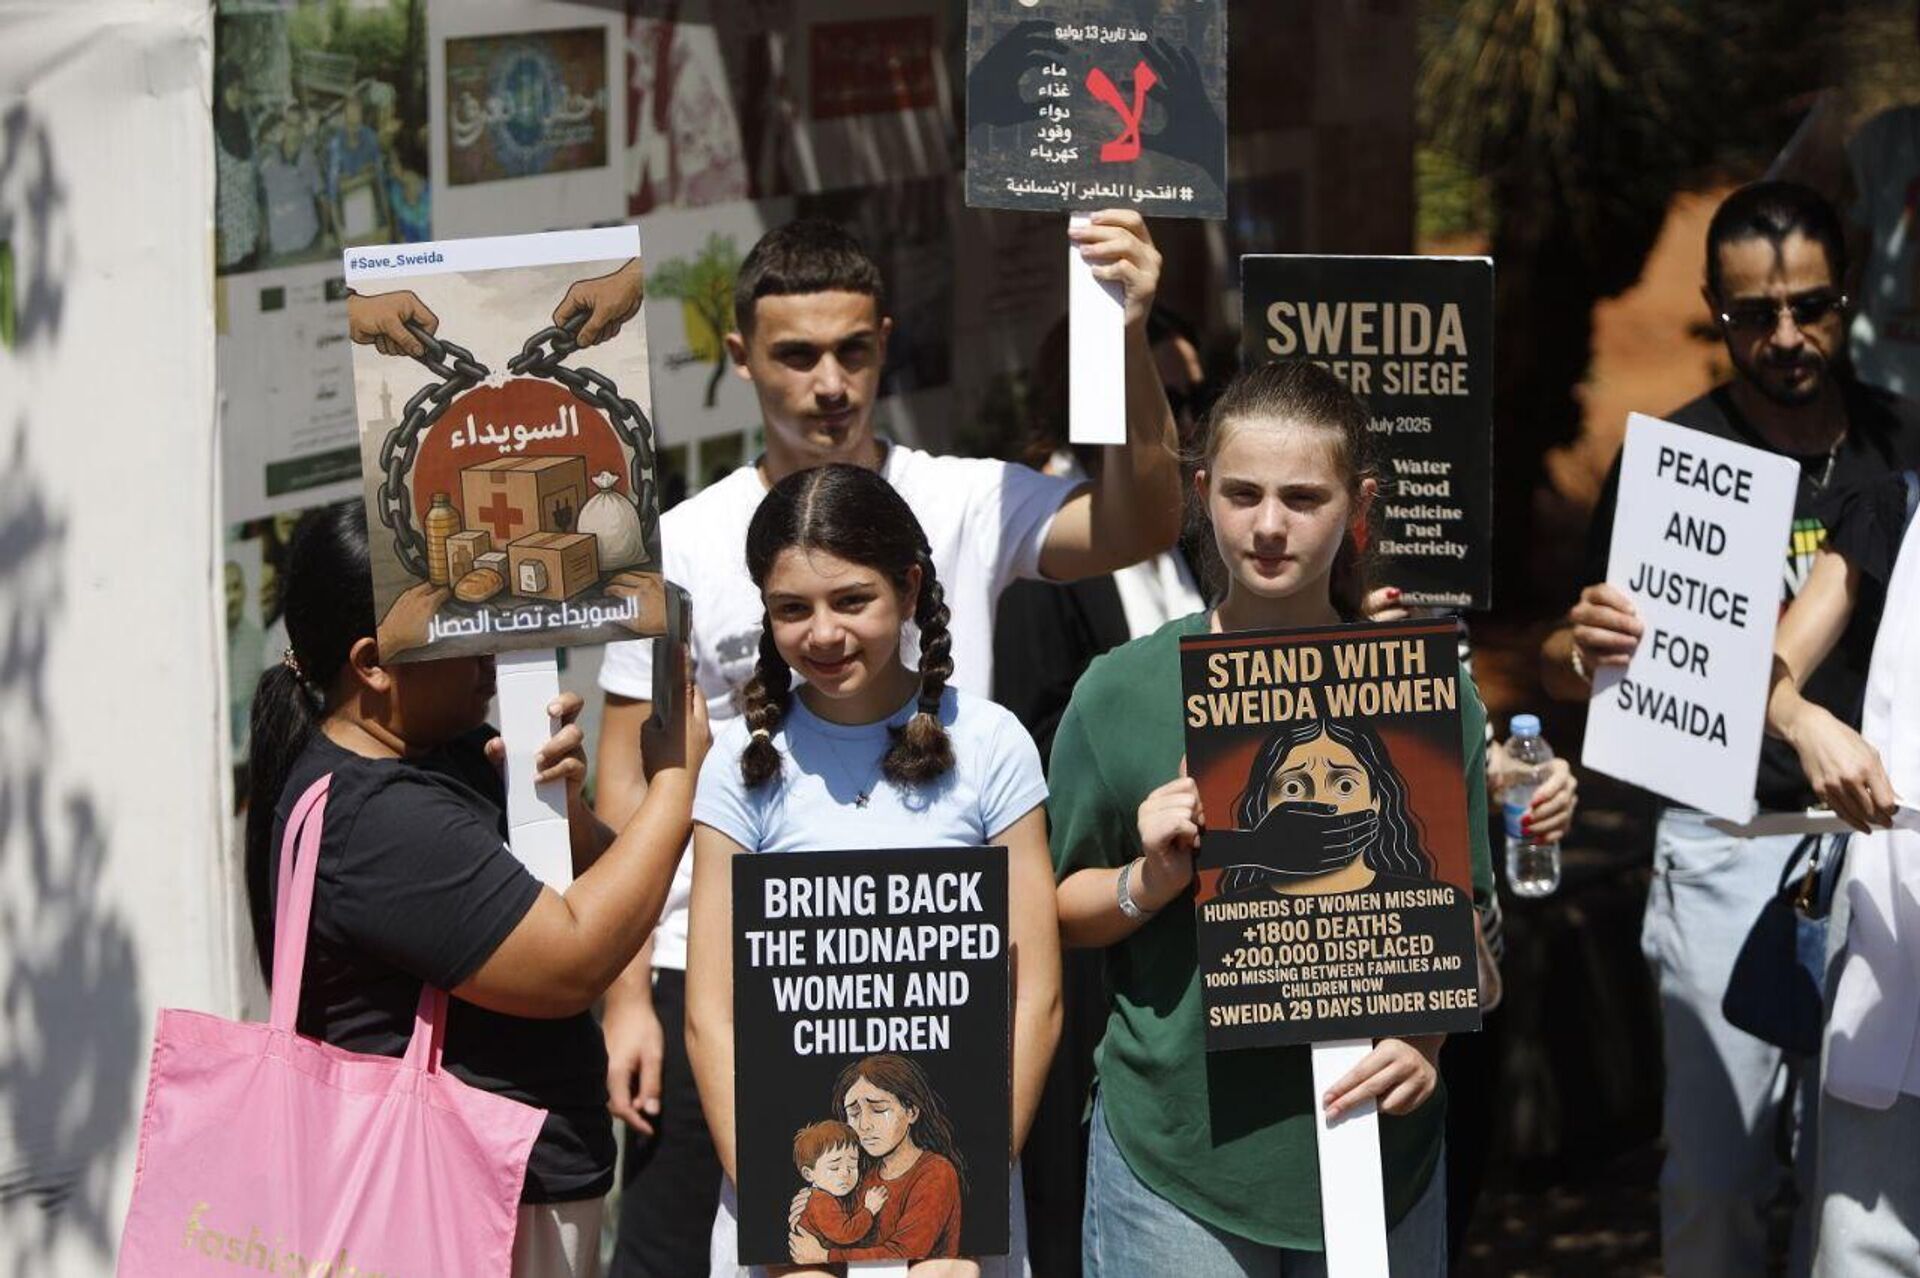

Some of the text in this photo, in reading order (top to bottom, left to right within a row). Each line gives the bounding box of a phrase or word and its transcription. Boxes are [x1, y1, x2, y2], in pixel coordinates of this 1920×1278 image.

[1055, 25, 1148, 44] منذ تاريخ 13 يوليو
[1042, 63, 1067, 77] ماء
[1038, 83, 1071, 97] غذاء
[1038, 103, 1070, 122] دواء
[1085, 59, 1158, 162] لا
[1037, 125, 1072, 143] وقود
[1030, 144, 1079, 163] كهرباء
[1005, 177, 1076, 201] الإنسانية
[1079, 183, 1124, 200] المعابر
[349, 251, 444, 270] #Save_Sweida
[1266, 301, 1468, 356] SWEIDA
[1382, 361, 1469, 395] SIEGE
[450, 404, 581, 454] السويداء
[1366, 417, 1432, 436] July 2025
[1391, 458, 1452, 475] Water
[1656, 446, 1753, 504] PEACE
[1397, 479, 1450, 497] Food
[1385, 504, 1463, 520] Medicine
[1404, 523, 1442, 537] Fuel
[1664, 512, 1726, 556] AND
[1378, 540, 1469, 560] Electricity
[1629, 562, 1749, 628] JUSTICE
[427, 596, 639, 644] السويداء تحت الحصار
[1208, 639, 1426, 688] STAND WITH
[1651, 629, 1710, 678] FOR
[1187, 677, 1456, 728] SWEIDA WOMEN
[1617, 678, 1728, 747] SWAIDA
[764, 871, 984, 919] BRING BACK
[1204, 888, 1455, 922] HUNDREDS OF WOMEN MISSING
[745, 923, 1001, 968] THE KIDNAPPED
[1243, 913, 1402, 944] +1800 DEATHS
[1221, 935, 1434, 970] +200,000 DISPLACED
[1205, 956, 1461, 988] 1000 MISSING BETWEEN FAMILIES AND
[1282, 977, 1384, 999] CHILDREN NOW
[772, 970, 970, 1012] WOMEN AND
[1210, 988, 1478, 1027] SWEIDA 29 DAYS UNDER SIEGE
[793, 1014, 950, 1056] CHILDREN
